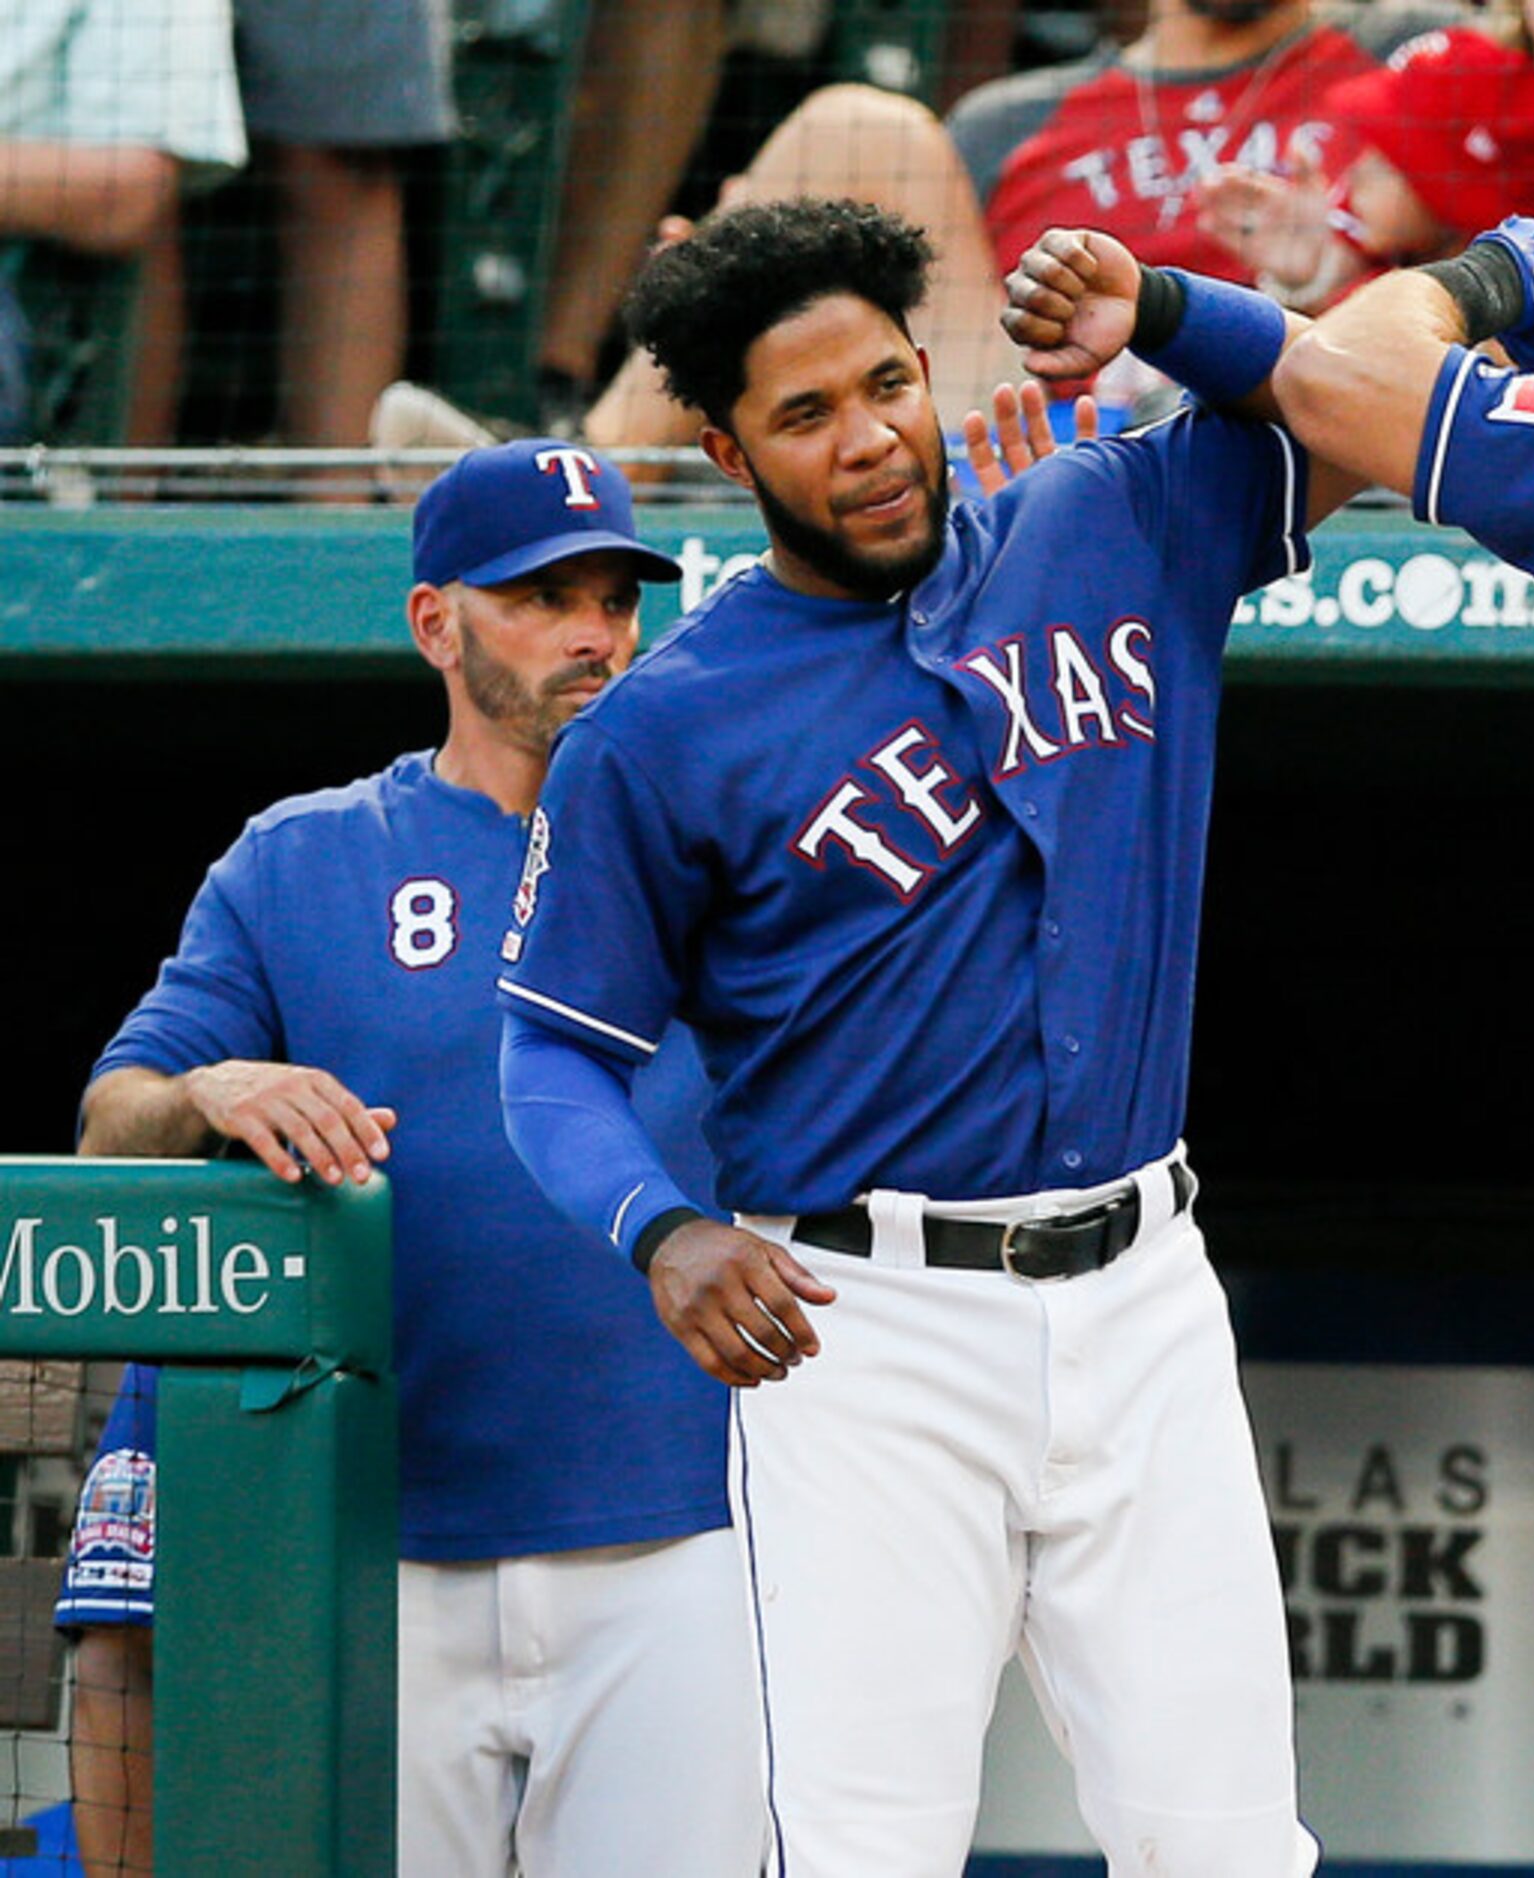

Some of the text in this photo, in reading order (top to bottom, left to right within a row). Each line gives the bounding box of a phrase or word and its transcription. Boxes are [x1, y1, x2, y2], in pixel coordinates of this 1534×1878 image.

[535, 449, 603, 511] T
[791, 615, 1156, 903] TEXAS
[388, 876, 459, 971] 8
[1274, 1443, 1488, 1516] LAS
